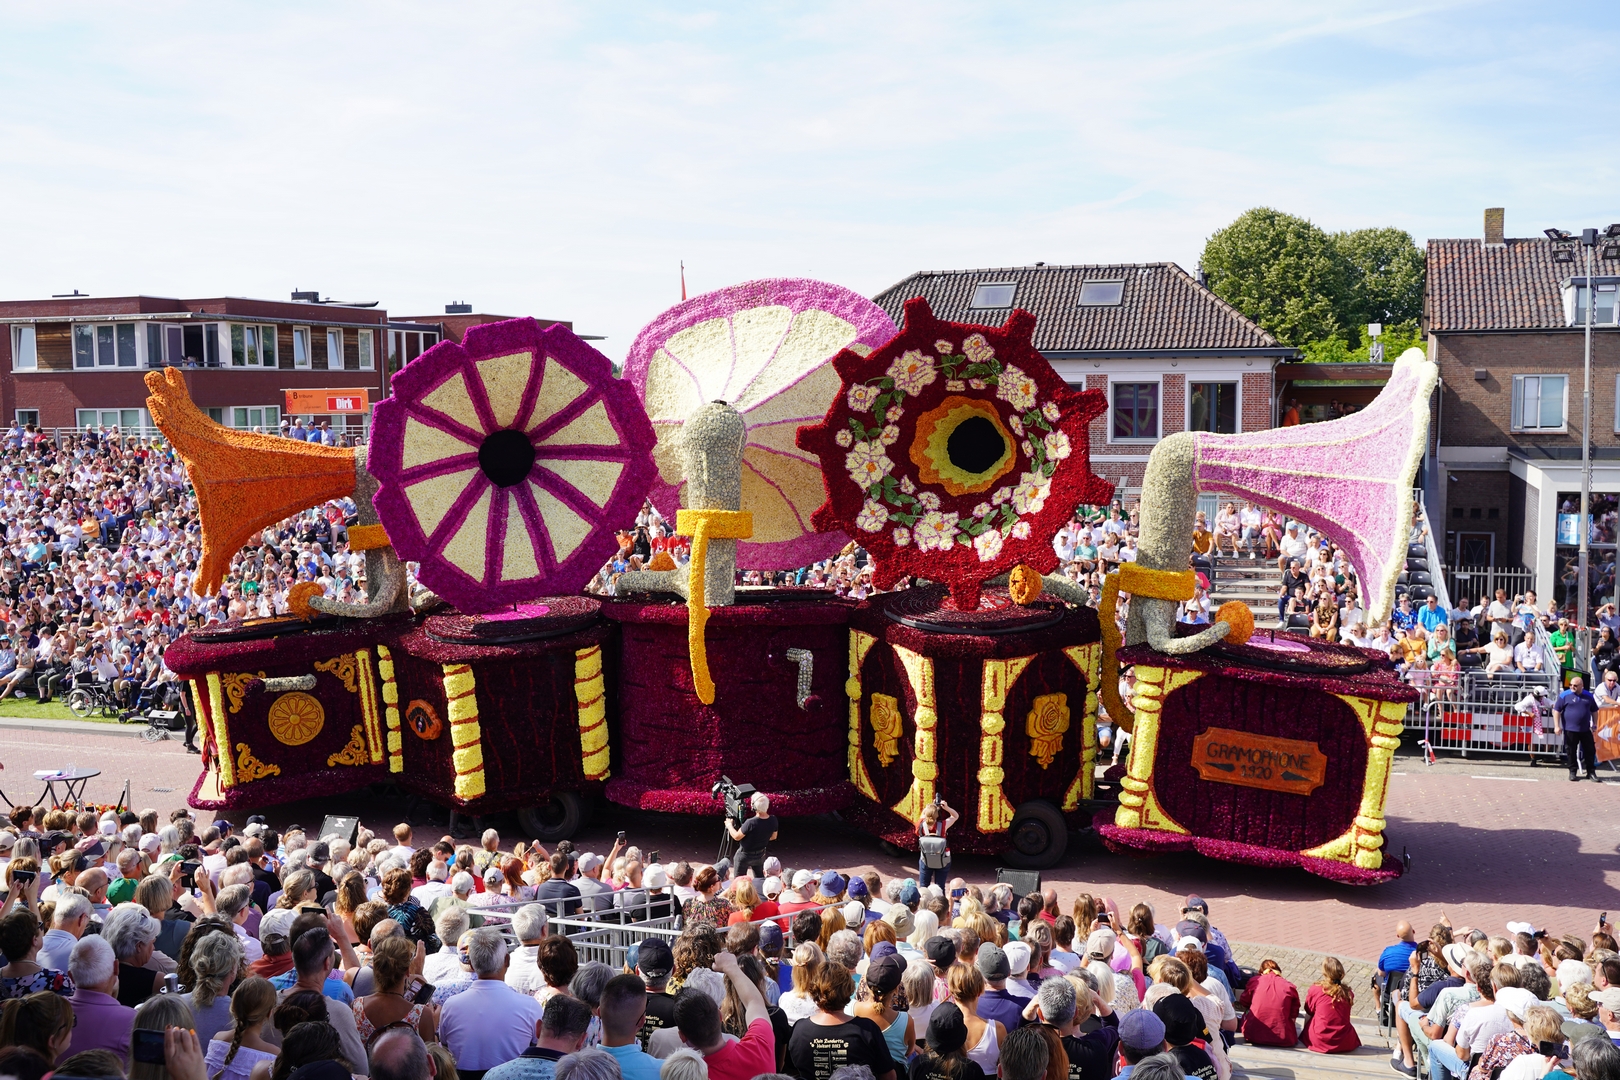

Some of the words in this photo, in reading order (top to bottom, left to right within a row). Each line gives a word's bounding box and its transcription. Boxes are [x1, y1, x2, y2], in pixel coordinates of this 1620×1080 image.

[336, 398, 353, 410] Dirk
[1206, 742, 1311, 770] GRAMOPHONE
[1240, 764, 1272, 780] 1920
